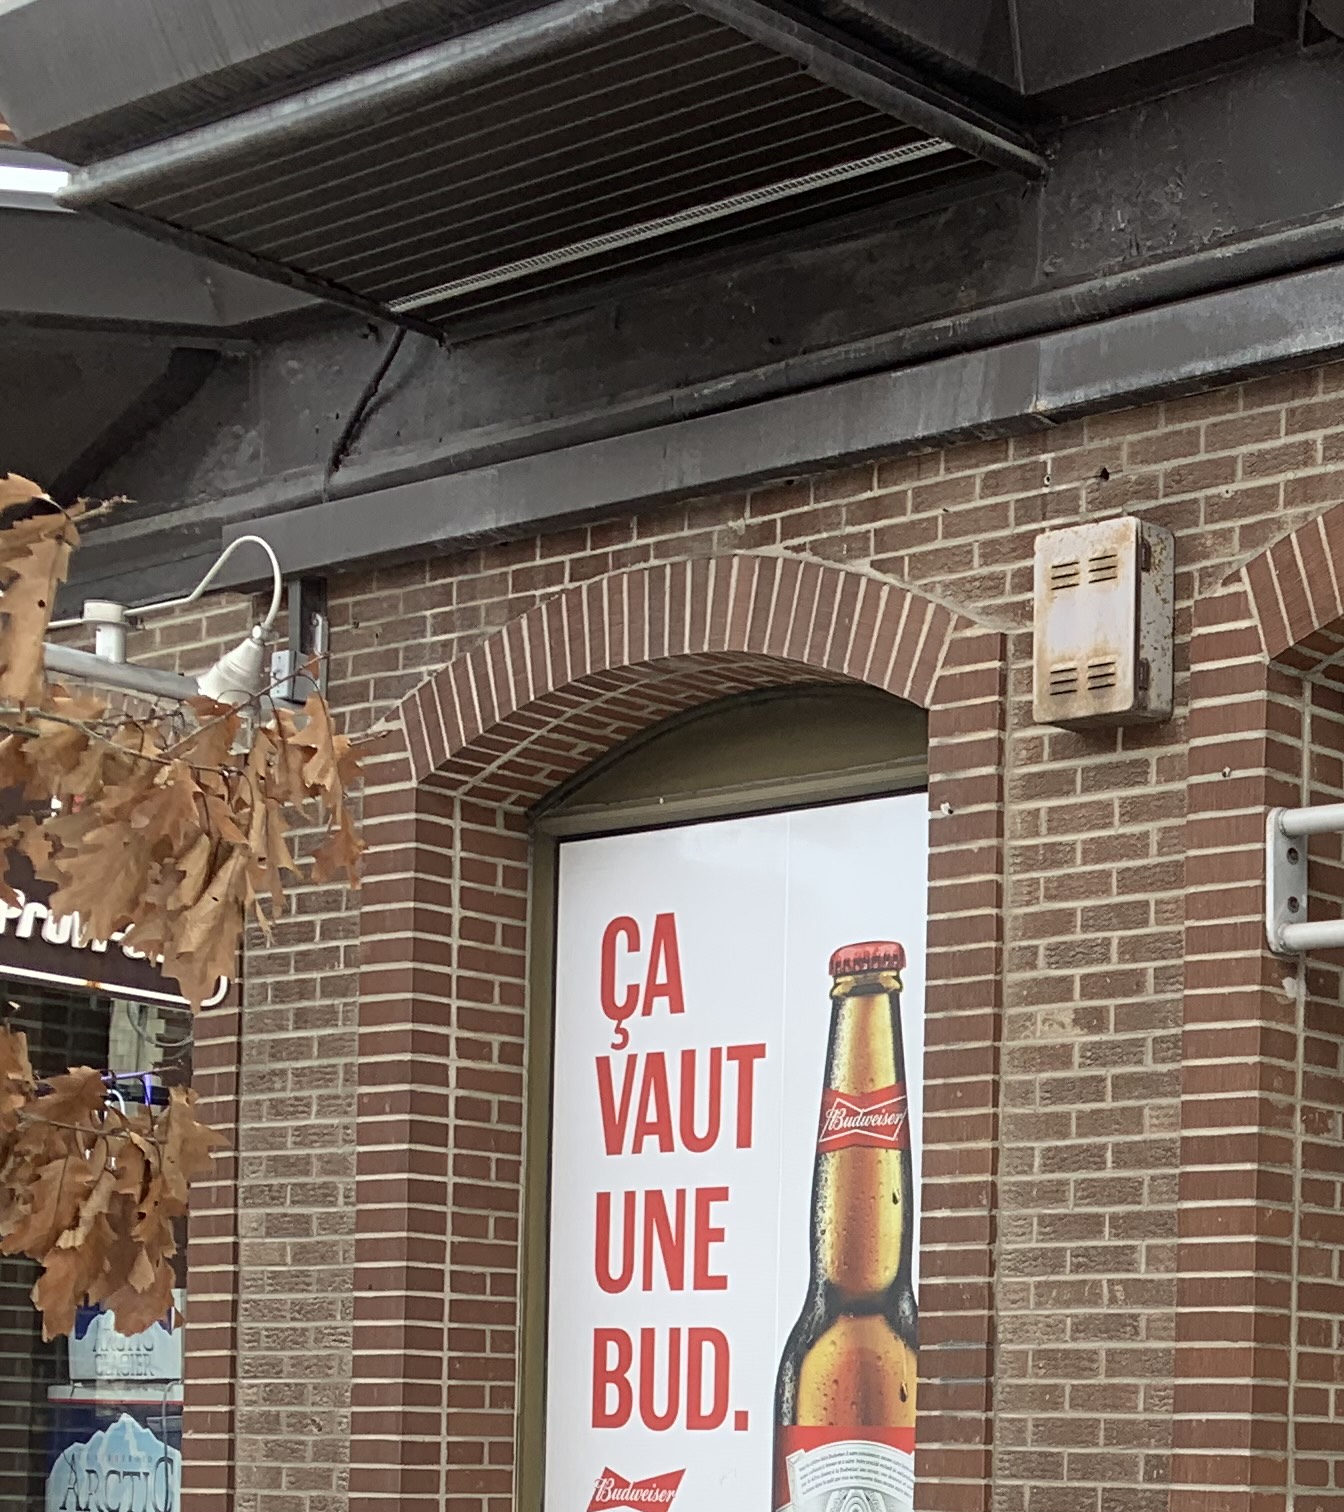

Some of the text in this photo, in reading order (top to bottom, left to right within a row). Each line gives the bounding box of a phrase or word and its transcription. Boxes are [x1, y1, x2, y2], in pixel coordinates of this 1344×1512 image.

[600, 913, 685, 1049] ÇA
[595, 1042, 767, 1157] VAUT
[826, 1107, 904, 1131] Budweiser
[594, 1185, 730, 1294] UNE
[591, 1327, 751, 1434] BUD.
[594, 1478, 678, 1503] Budweiser
